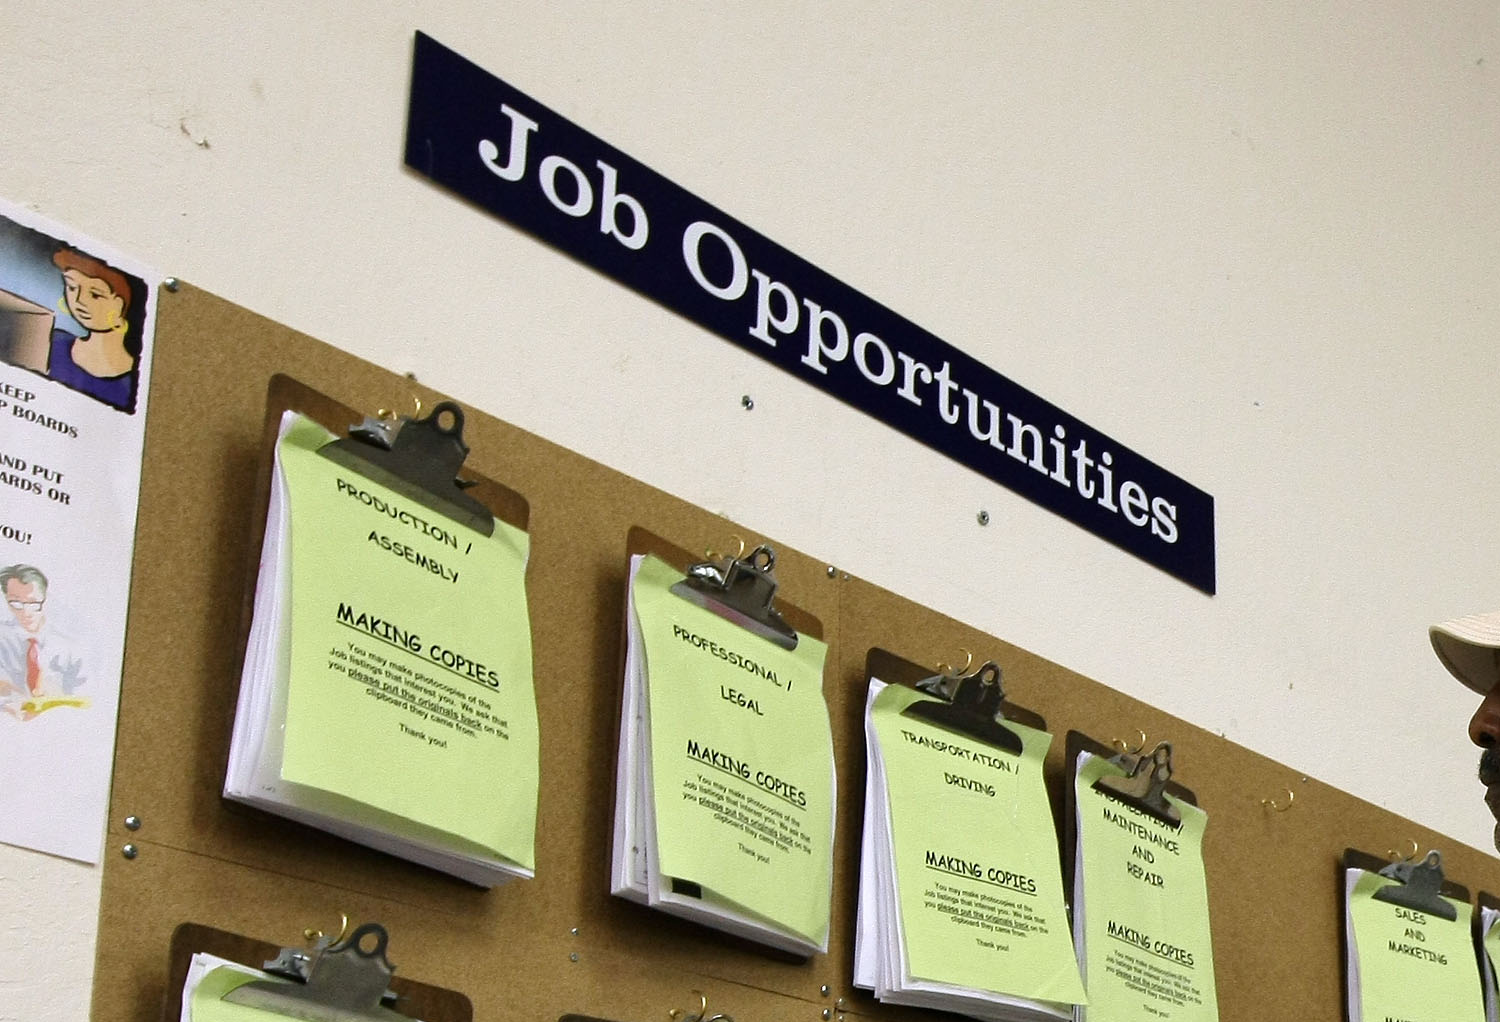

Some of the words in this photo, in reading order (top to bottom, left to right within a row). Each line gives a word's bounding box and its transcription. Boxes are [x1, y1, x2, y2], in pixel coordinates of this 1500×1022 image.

[478, 104, 649, 250] Job
[682, 220, 1179, 545] Opportunities
[13, 404, 78, 439] BOARDS
[32, 464, 64, 484] PUT
[48, 487, 70, 505] OR
[337, 478, 457, 549] PRODUCTION
[0, 524, 32, 545] OU!
[368, 531, 458, 583] ASSEMBLY
[337, 603, 422, 652] MAKING
[429, 645, 499, 687] COPIES
[673, 624, 782, 687] PROFESSIONAL
[721, 685, 763, 716] LEGAL
[901, 730, 1011, 772] TRANSPORTATION
[687, 740, 750, 778] MAKING
[755, 771, 806, 805] COPIES
[944, 772, 996, 797] DRIVING
[1103, 807, 1179, 855] MAINTENANCE
[926, 851, 982, 878] MAKING
[988, 868, 1036, 892] COPIES
[1132, 845, 1154, 864] AND
[1127, 861, 1164, 888] REPAIR
[1395, 908, 1426, 925] SALES
[1108, 920, 1151, 949] MAKING
[1153, 941, 1194, 965] COPIES
[1389, 940, 1447, 965] MARKETING
[1404, 928, 1425, 942] AND
